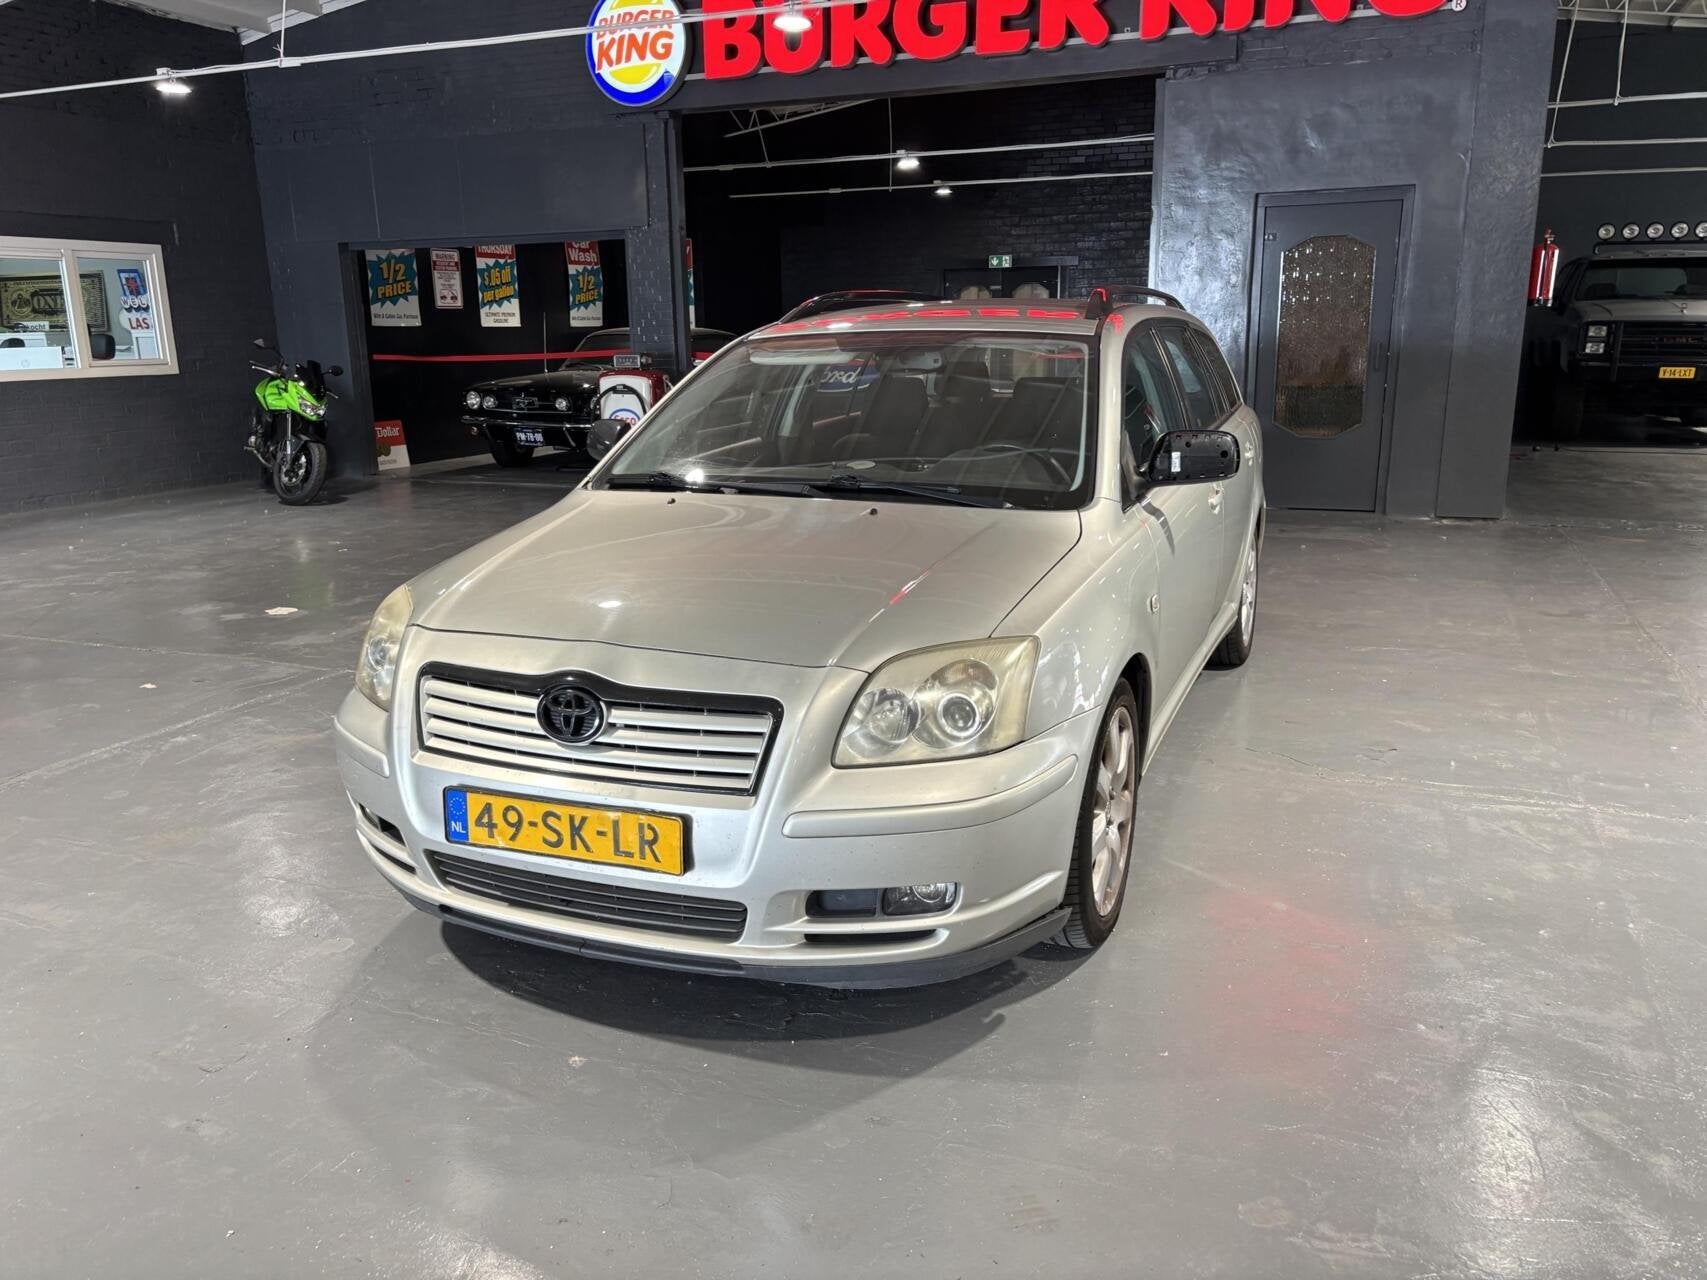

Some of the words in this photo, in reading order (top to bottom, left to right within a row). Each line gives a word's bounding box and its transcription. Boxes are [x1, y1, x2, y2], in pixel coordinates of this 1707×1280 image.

[596, 9, 675, 40] BURGER
[596, 30, 674, 71] KING
[702, 0, 1109, 80] BURGER
[568, 247, 598, 263] Wash
[379, 258, 406, 284] 1/2
[577, 271, 596, 293] 1/2
[377, 281, 413, 299] PRICE
[575, 289, 599, 304] PRICE
[128, 317, 150, 330] LAS
[374, 426, 400, 437] Dollar
[451, 820, 467, 834] NL
[473, 801, 662, 863] 49-SK-LR
